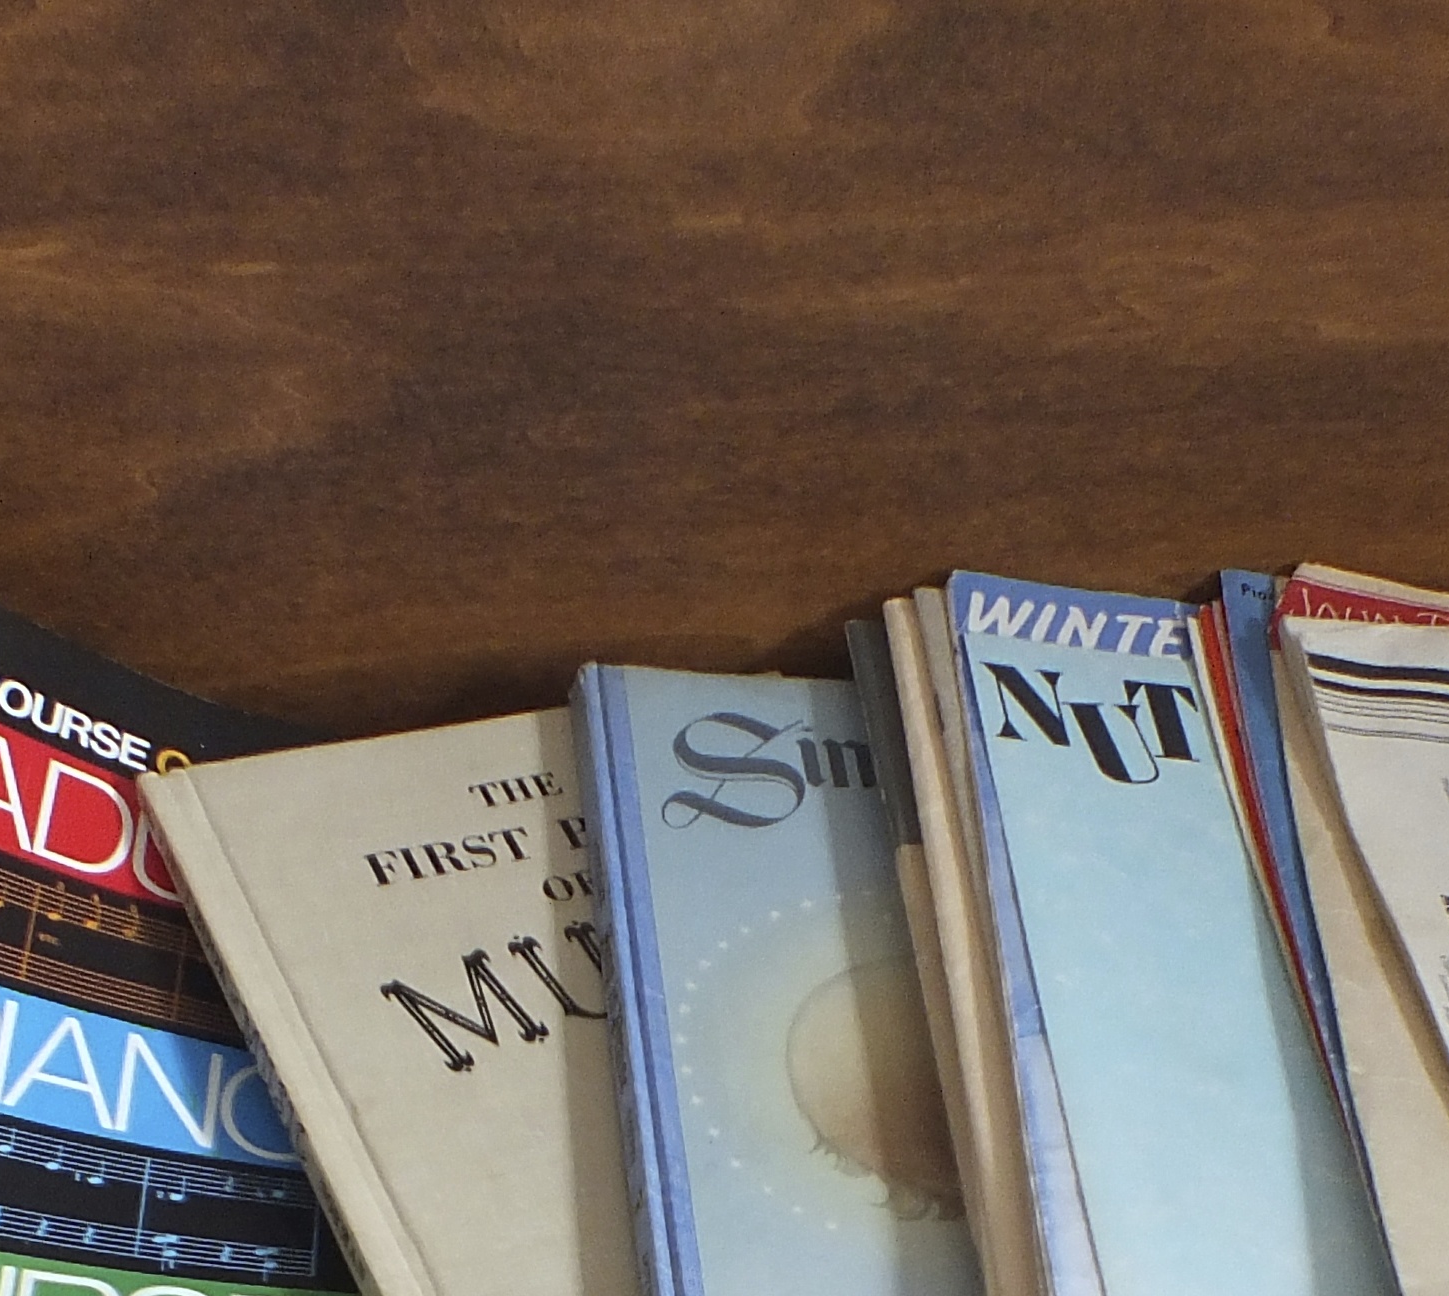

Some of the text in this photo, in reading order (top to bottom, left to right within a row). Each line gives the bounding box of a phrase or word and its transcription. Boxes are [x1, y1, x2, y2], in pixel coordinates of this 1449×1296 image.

[979, 661, 1200, 784] NUT
[468, 772, 563, 807] THE
[364, 826, 531, 886] FIRST
